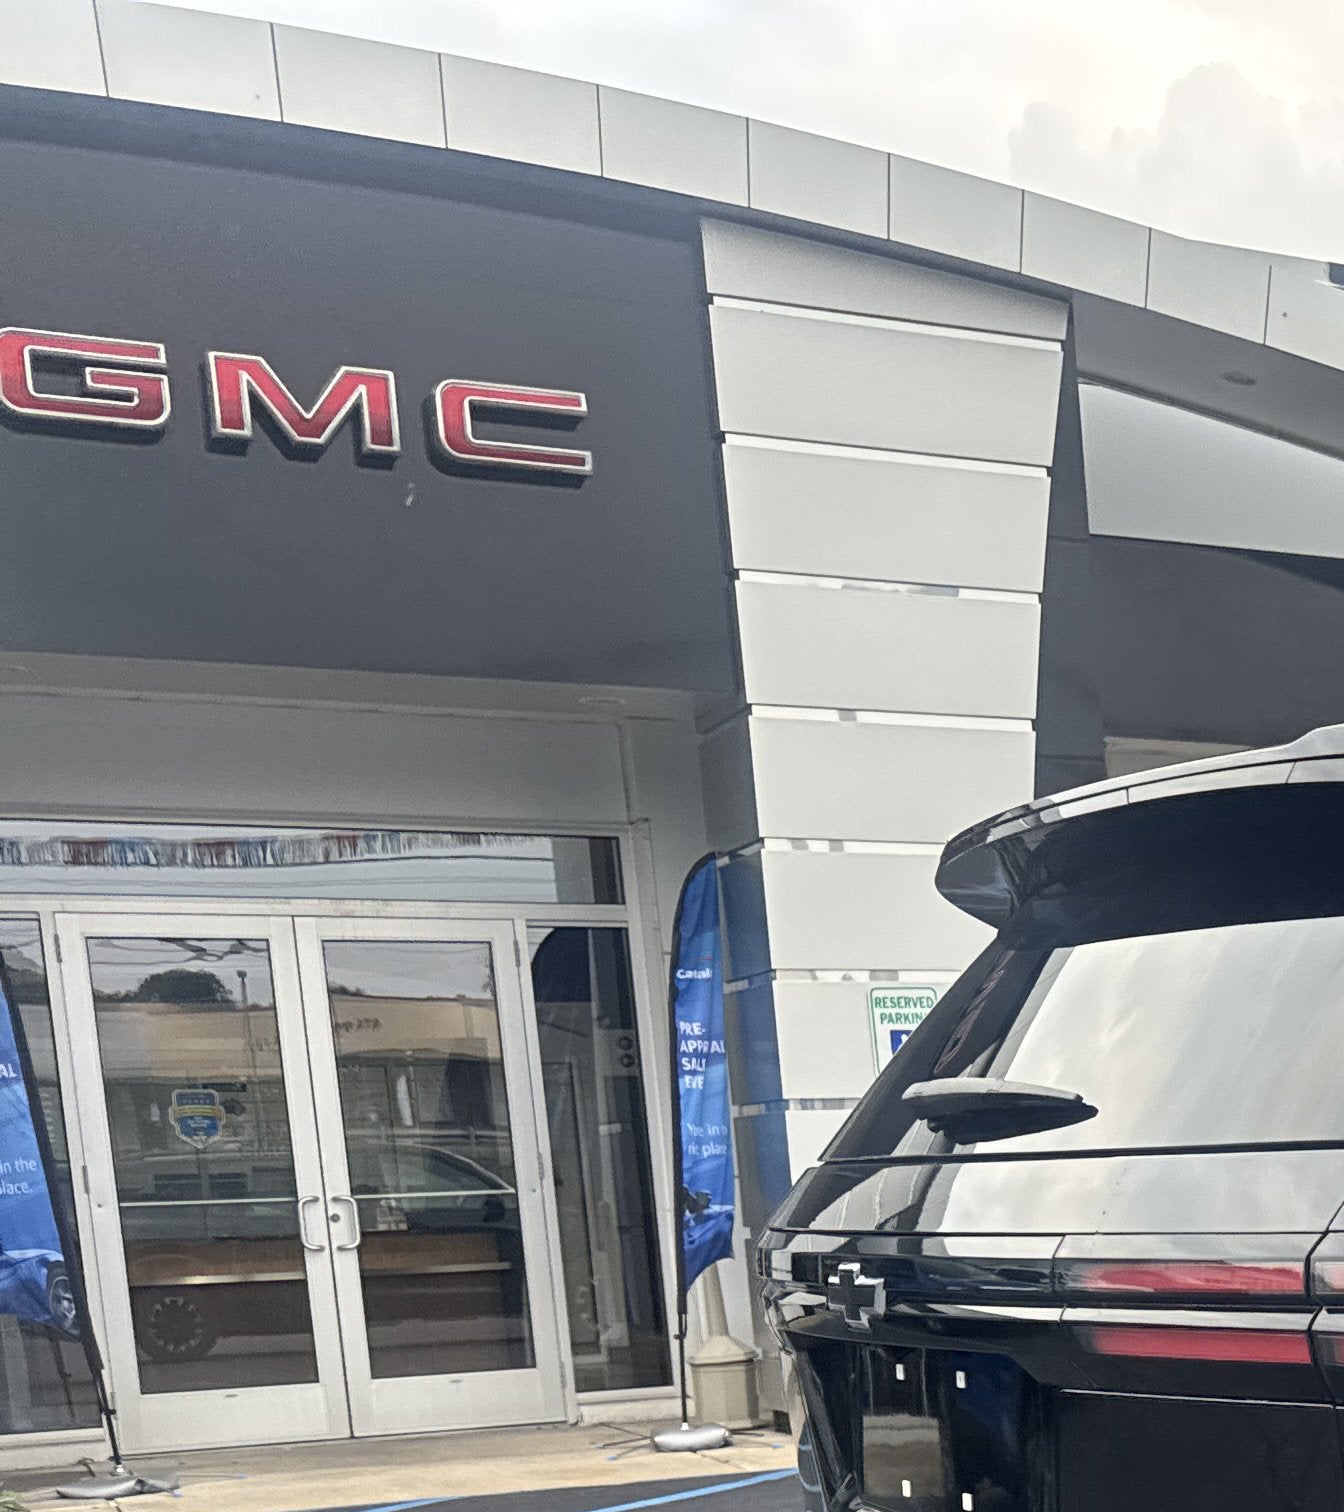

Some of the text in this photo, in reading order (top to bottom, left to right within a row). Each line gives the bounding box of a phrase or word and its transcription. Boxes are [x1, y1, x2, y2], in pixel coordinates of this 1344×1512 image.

[0, 326, 593, 476] GMC
[874, 996, 935, 1009] RESERVED
[880, 1012, 924, 1025] PARKIN
[679, 1021, 706, 1036] PRE-
[15, 1159, 37, 1172] the
[0, 1182, 33, 1195] lace.
